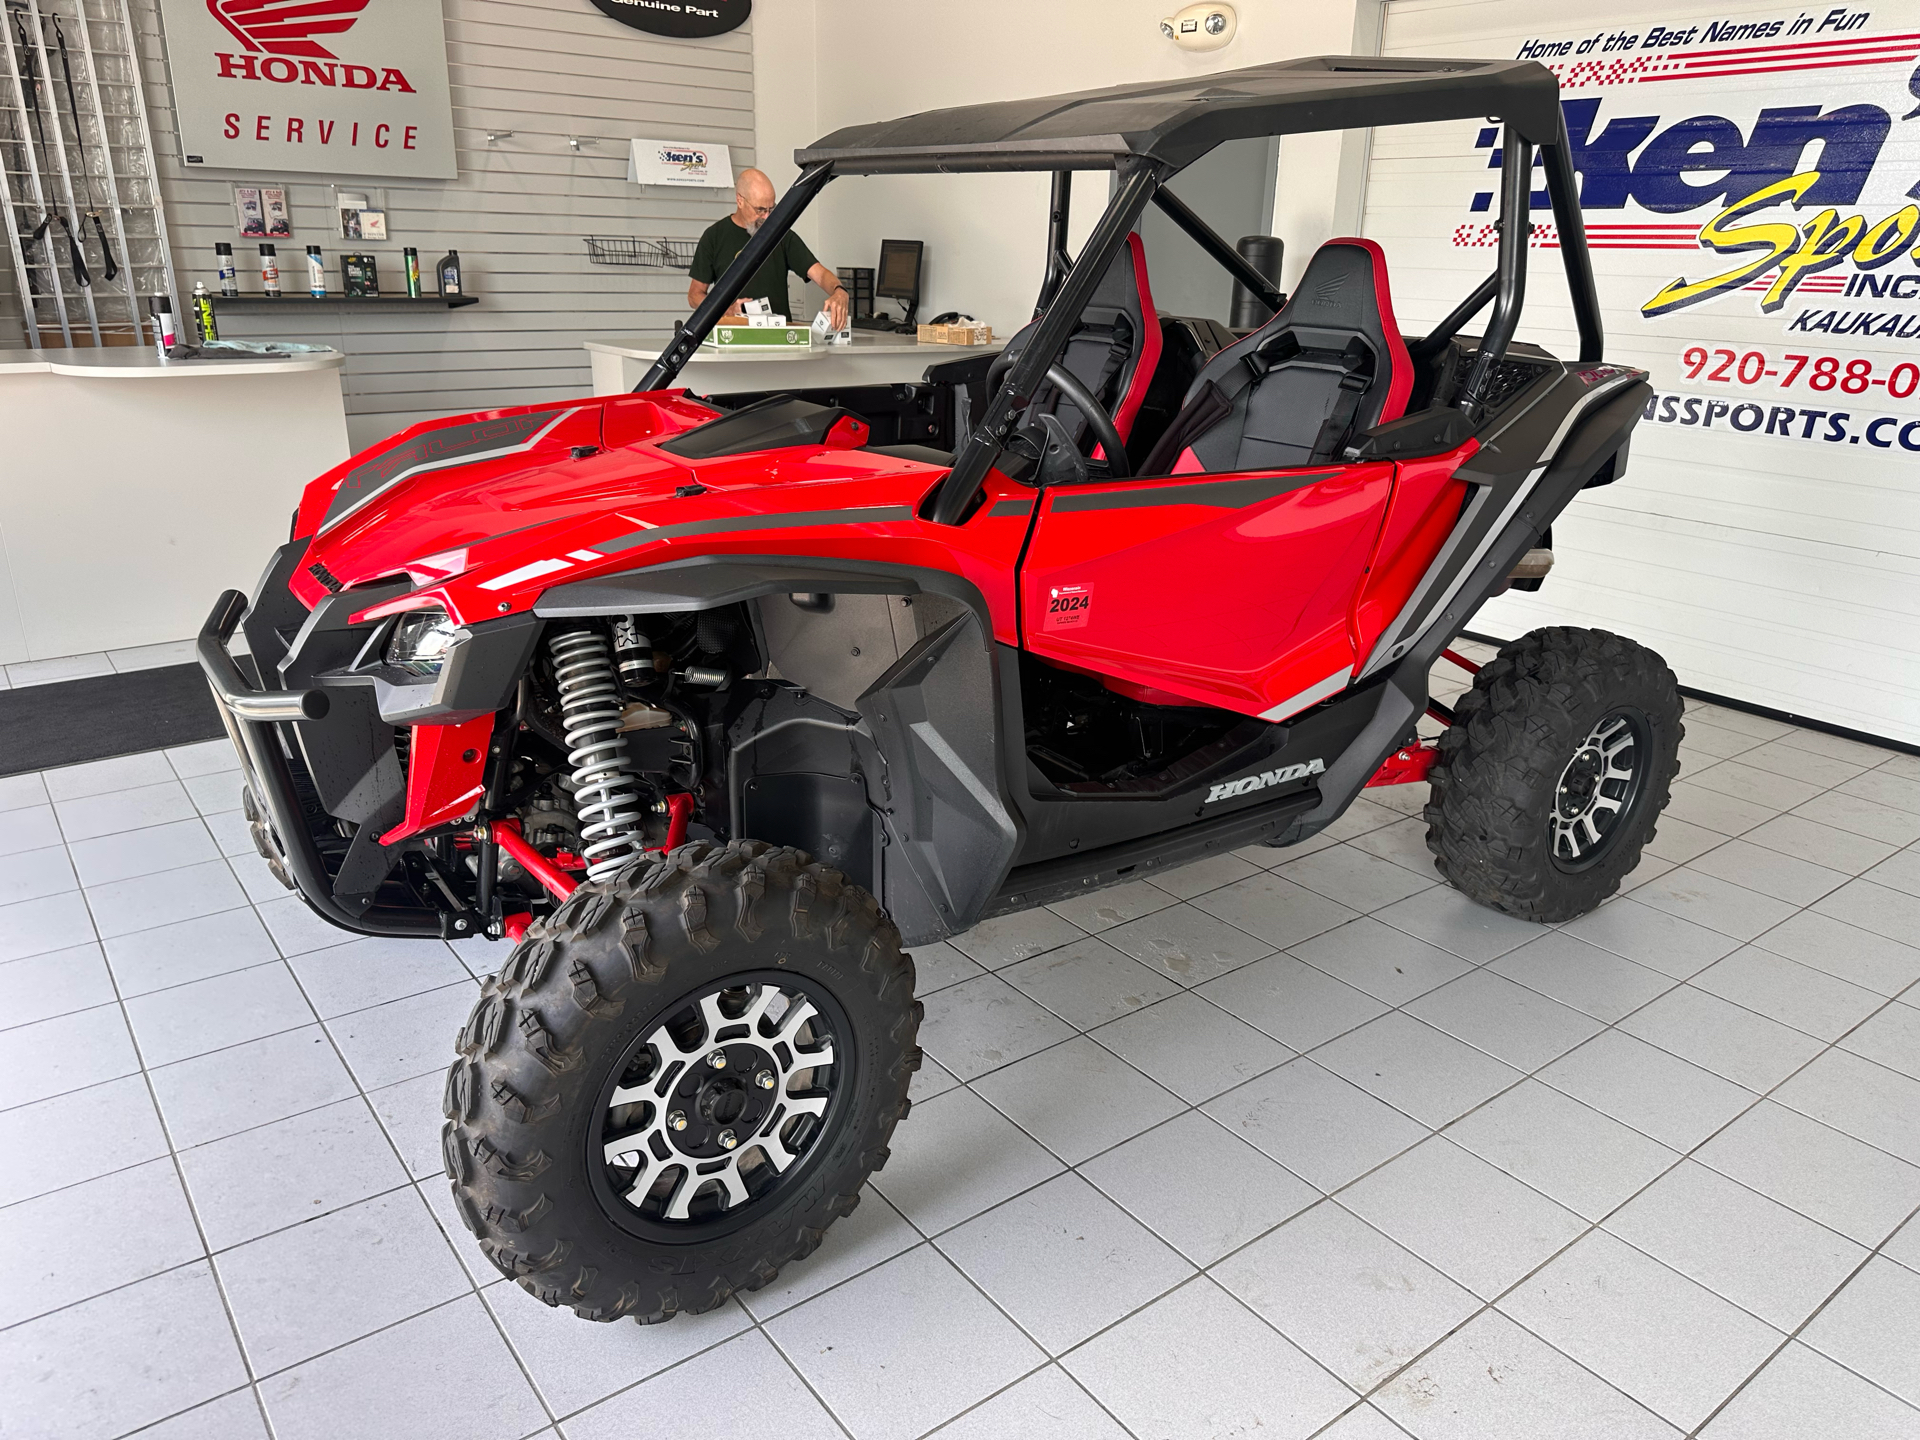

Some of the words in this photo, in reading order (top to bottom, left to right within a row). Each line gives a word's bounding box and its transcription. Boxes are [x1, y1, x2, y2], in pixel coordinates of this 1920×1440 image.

[611, 0, 681, 12] enuine
[685, 5, 719, 18] Part
[1516, 39, 1573, 60] Home
[1576, 33, 1604, 54] of
[1602, 31, 1639, 52] the
[1641, 25, 1699, 48] Best
[1699, 20, 1785, 43] Names
[1786, 13, 1814, 35] in
[1816, 8, 1870, 33] Fun
[214, 52, 417, 94] HONDA
[224, 113, 418, 150] SERVICE
[666, 151, 704, 164] ken's
[1788, 309, 1920, 339] KAUKAU
[1683, 346, 1920, 400] 920-788-0
[308, 562, 344, 593] HONDA
[1050, 595, 1089, 613] 2024
[1204, 757, 1327, 804] HONDA
